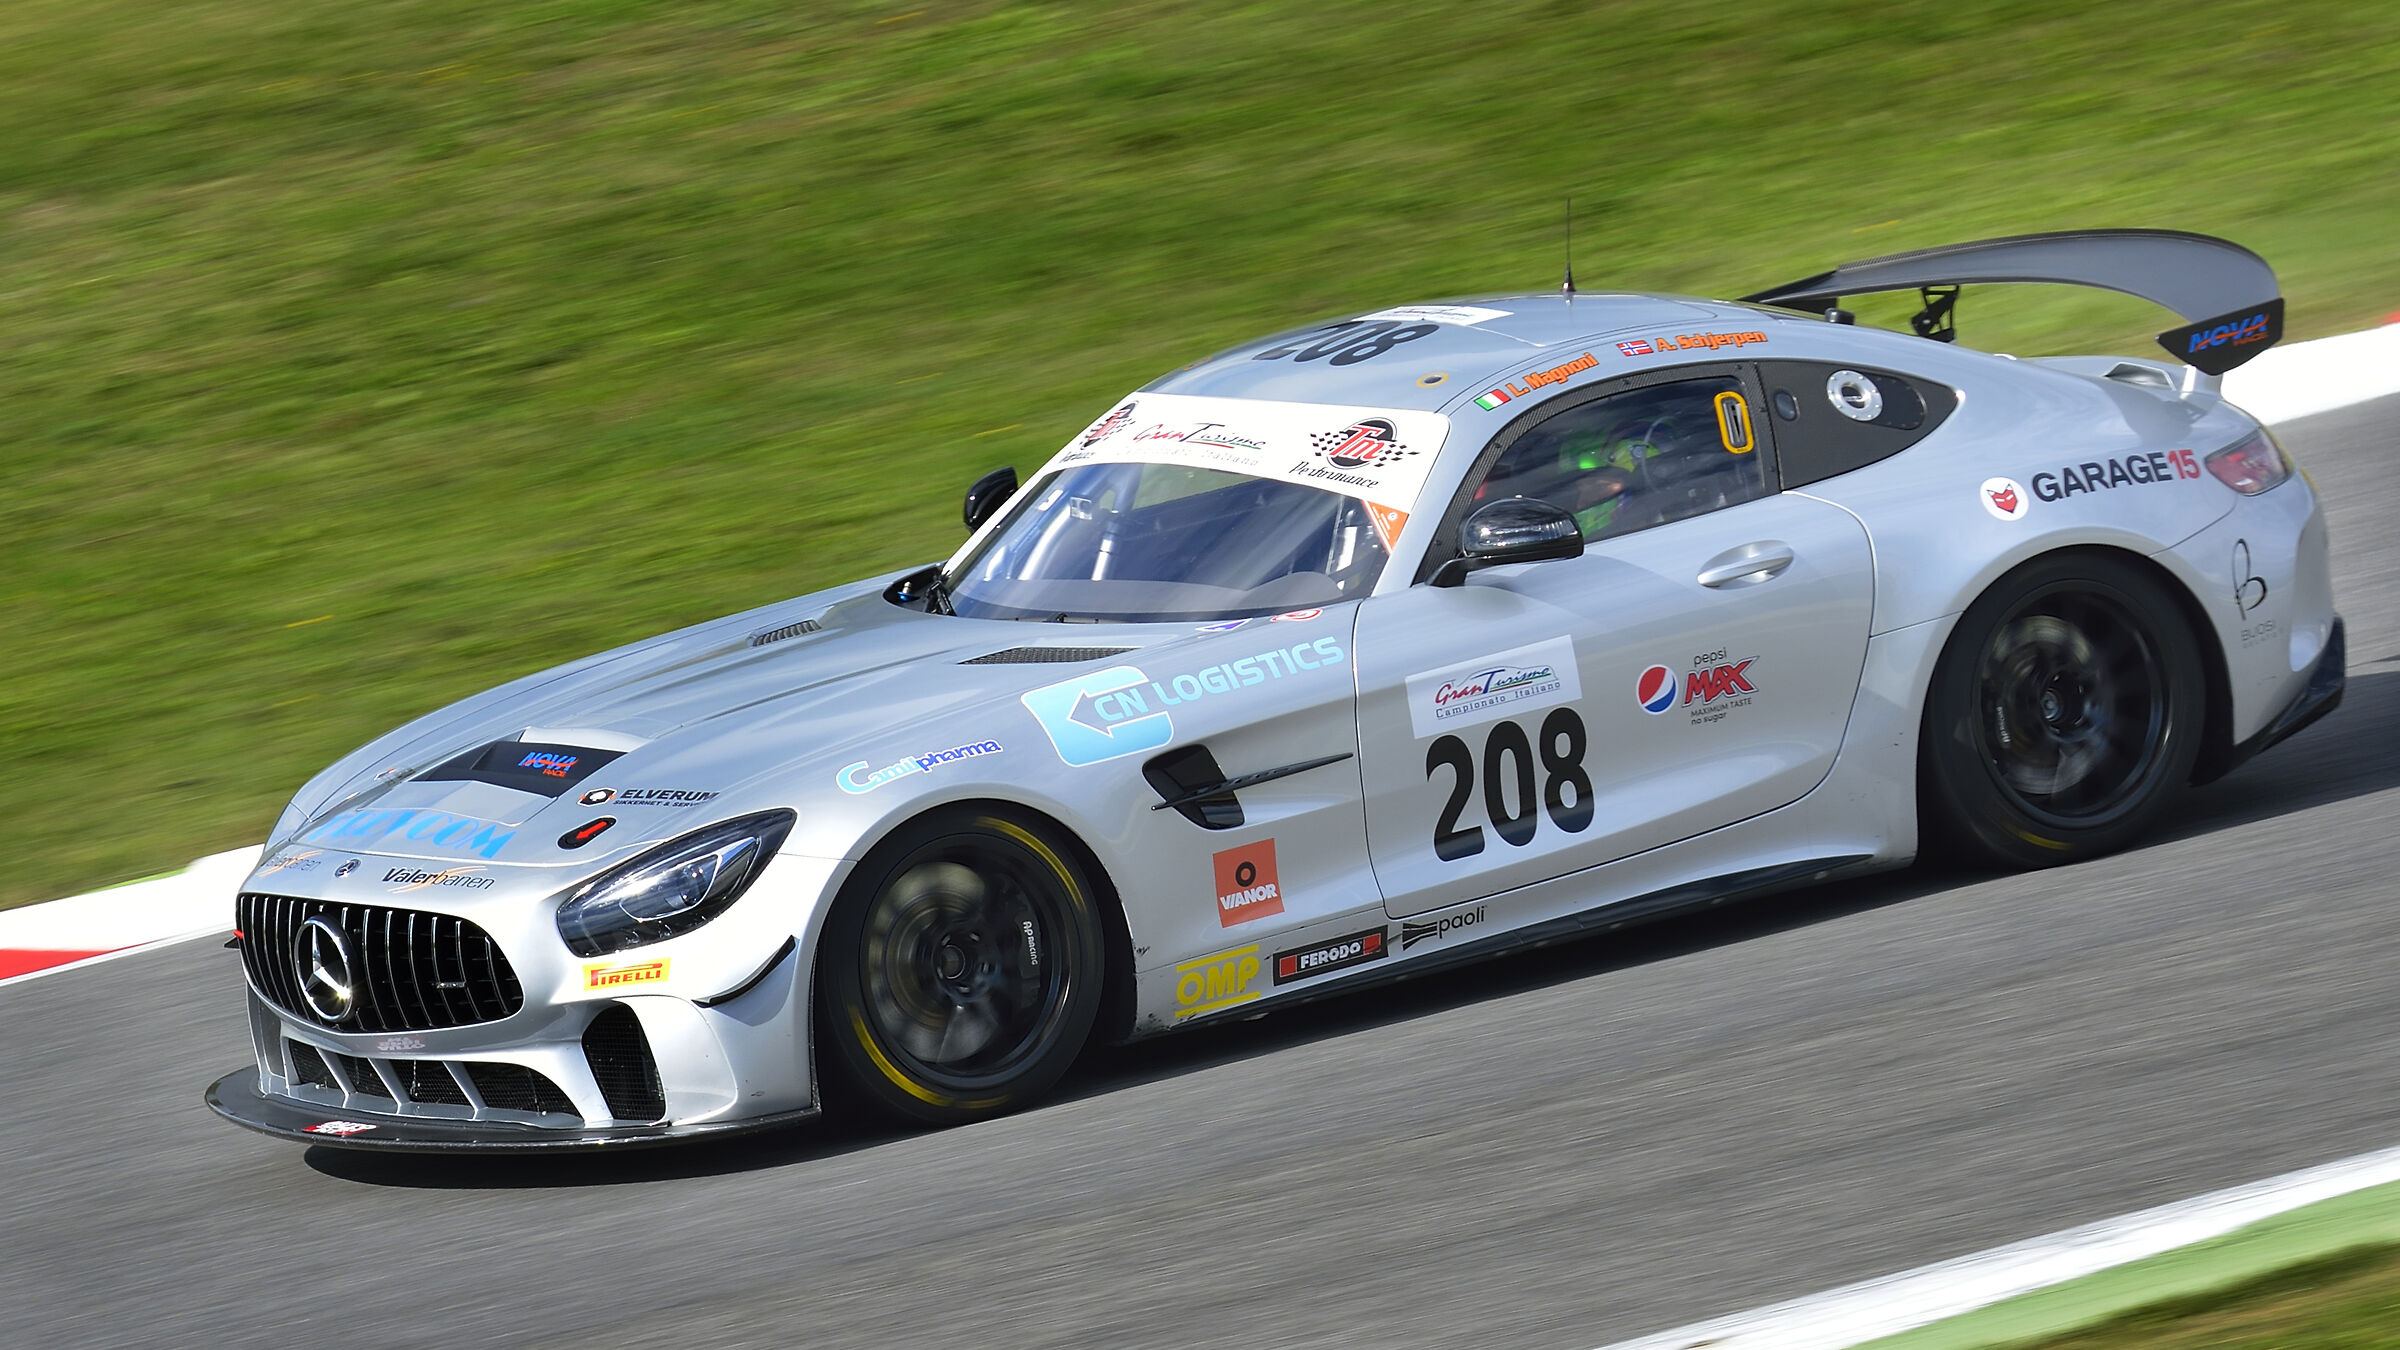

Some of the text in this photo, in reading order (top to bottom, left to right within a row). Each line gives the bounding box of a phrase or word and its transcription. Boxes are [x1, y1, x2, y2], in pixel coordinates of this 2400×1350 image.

[1655, 331, 1768, 352] A. Schjerpen
[2188, 313, 2268, 353] NOVA
[1506, 352, 1600, 398] L. Magnoni
[2032, 449, 2202, 503] GARAGE15
[1693, 646, 1728, 668] pepsi
[1094, 635, 1346, 722] CN LOGISTICS
[1682, 656, 1760, 708] MAX
[1435, 681, 1561, 718] Campionato Italiano
[1690, 697, 1753, 718] MAXIMUM TASTE
[1691, 711, 1728, 725] no sugar
[518, 752, 578, 772] NOVA
[620, 789, 720, 801] ELVERUM
[1425, 706, 1595, 862] 208
[1220, 883, 1278, 911] VIANOR
[1438, 906, 1486, 939] paoli
[1022, 921, 1039, 966] AP RACING
[1300, 941, 1361, 970] FERODO
[590, 963, 663, 987] PIRELLI
[1176, 956, 1260, 1006] OMP
